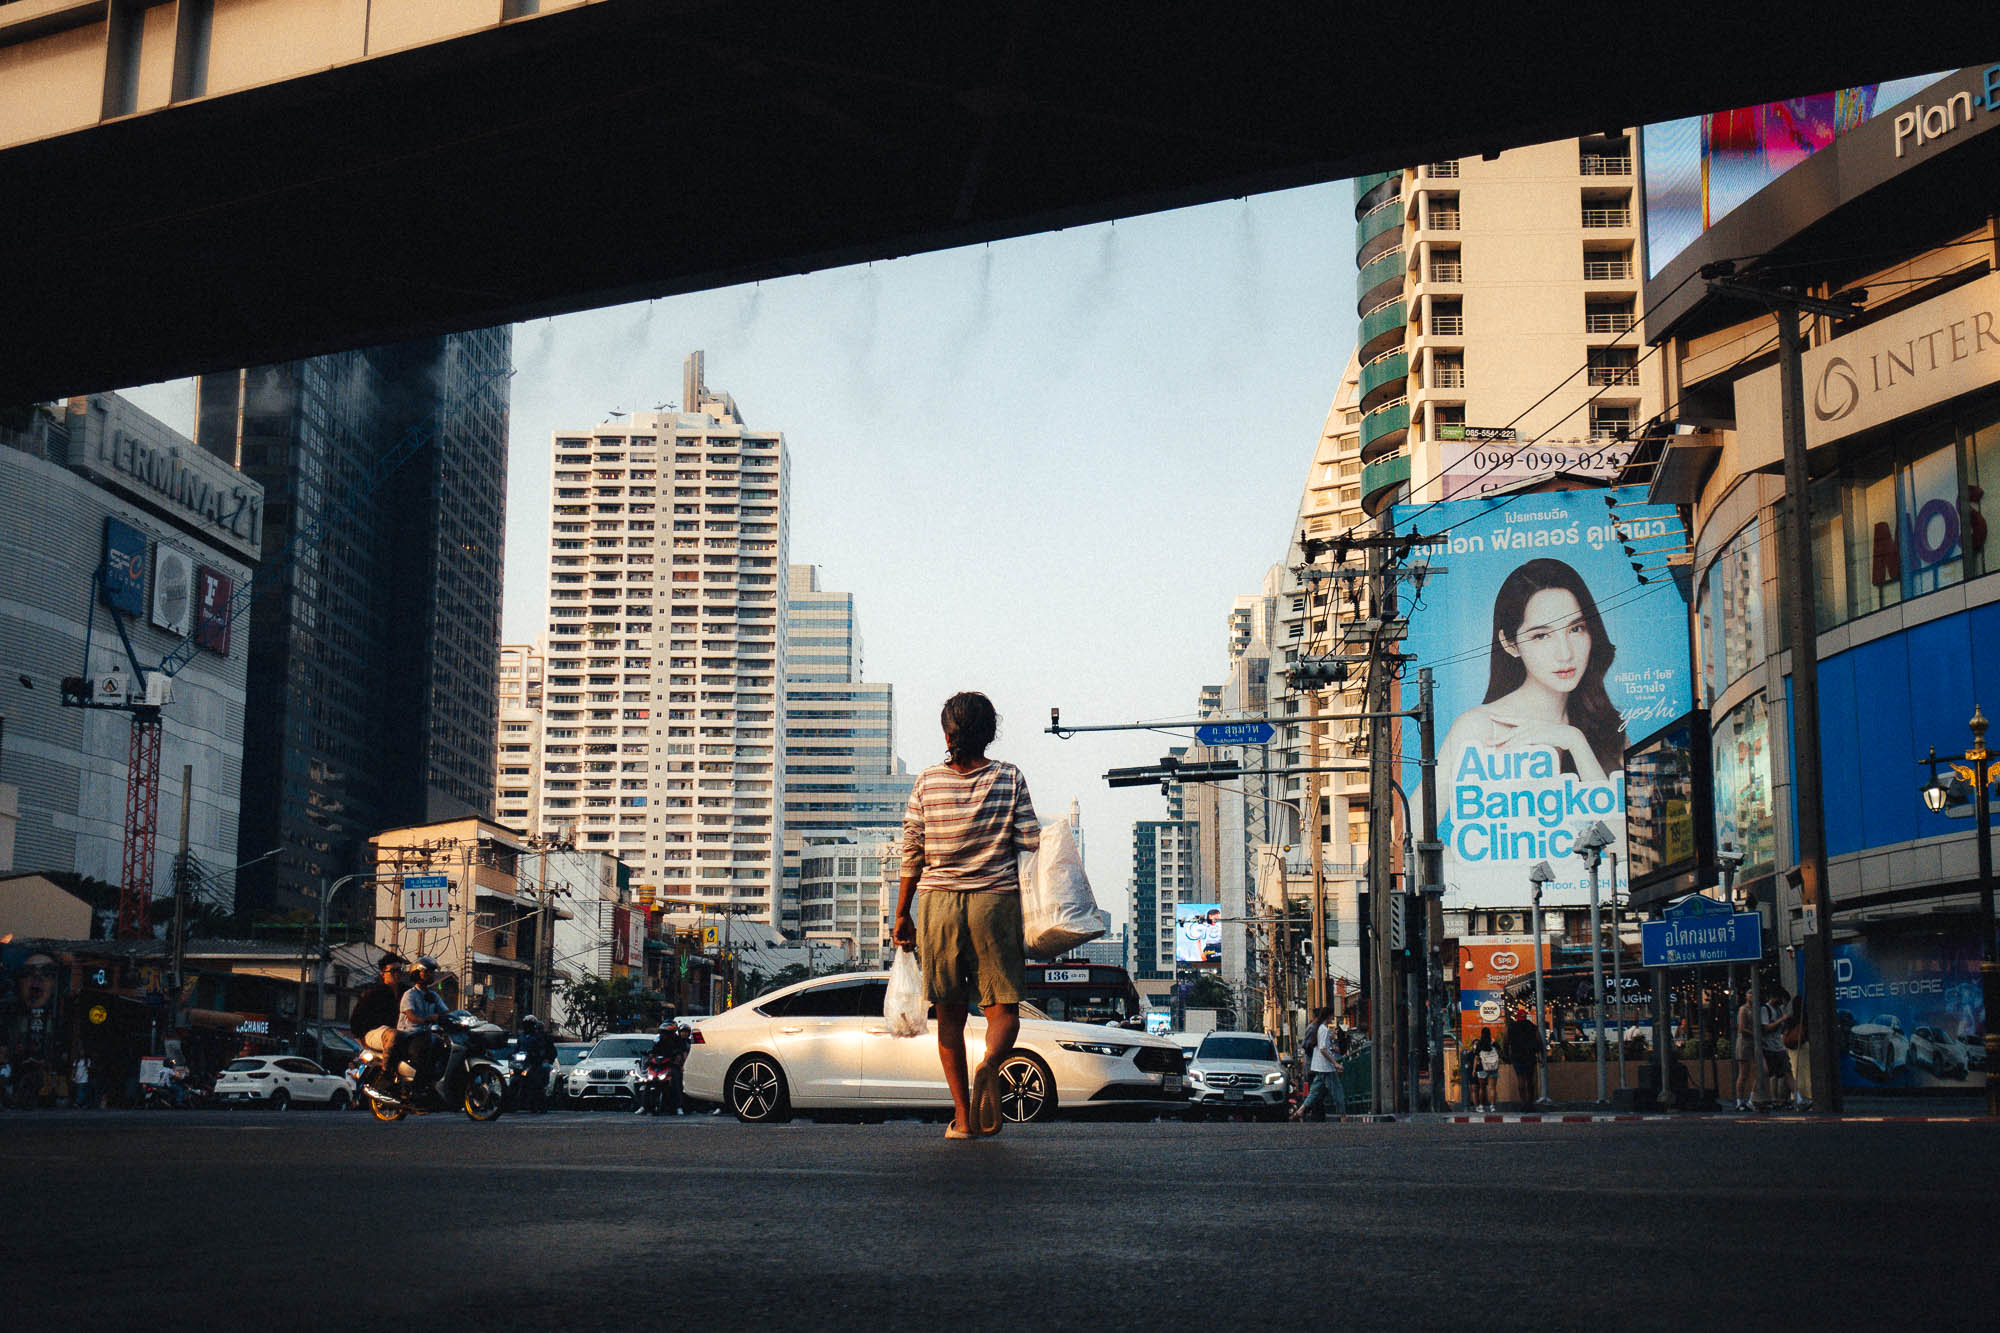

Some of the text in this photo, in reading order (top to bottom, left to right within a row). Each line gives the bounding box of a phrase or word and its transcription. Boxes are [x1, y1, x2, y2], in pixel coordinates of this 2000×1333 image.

[1869, 311, 2000, 393] INTER
[1490, 521, 1580, 550] ฟิลเลอร์
[1456, 746, 1553, 782] Aura
[1457, 822, 1574, 862] Clinic
[1665, 918, 1737, 947] อโศกมนตรี
[1675, 948, 1728, 961] Asok Montri
[1048, 971, 1069, 981] 136
[1888, 979, 1944, 996] STORE
